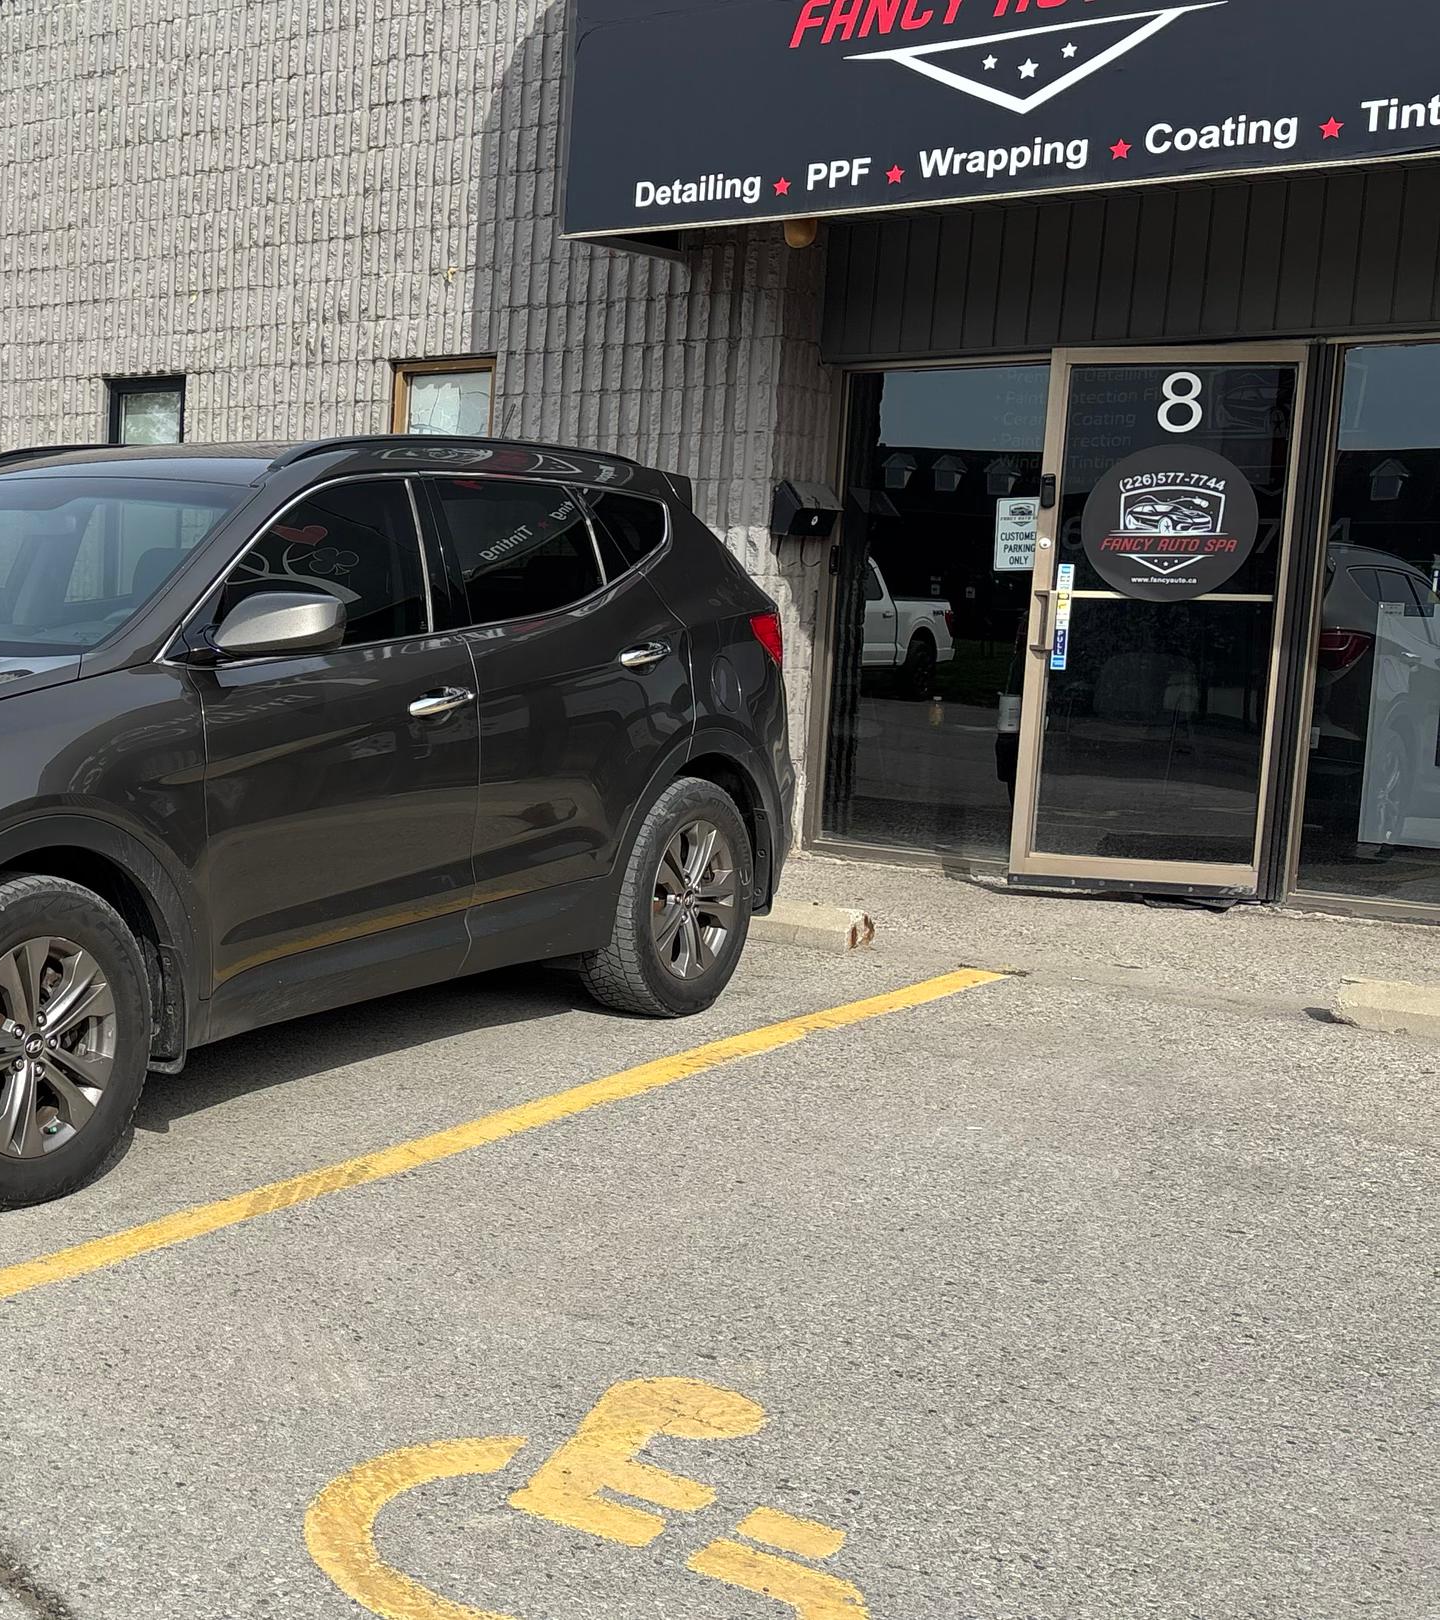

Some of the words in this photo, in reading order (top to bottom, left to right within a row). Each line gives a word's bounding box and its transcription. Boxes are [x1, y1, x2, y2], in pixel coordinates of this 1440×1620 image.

[634, 174, 761, 207] Detailing
[807, 157, 872, 191] PPF
[919, 136, 1089, 178] Wrapping
[1145, 114, 1298, 154] Coating
[1361, 95, 1440, 132] Tint
[1156, 371, 1203, 433] 8
[1119, 472, 1226, 492] (226)577-7744
[1000, 532, 1037, 541] CUSTOME
[1003, 544, 1036, 553] PARKING
[1100, 538, 1155, 551] FANCY
[1157, 538, 1200, 551] AUTO
[1204, 539, 1238, 552] SPA
[1009, 556, 1029, 565] ONLY
